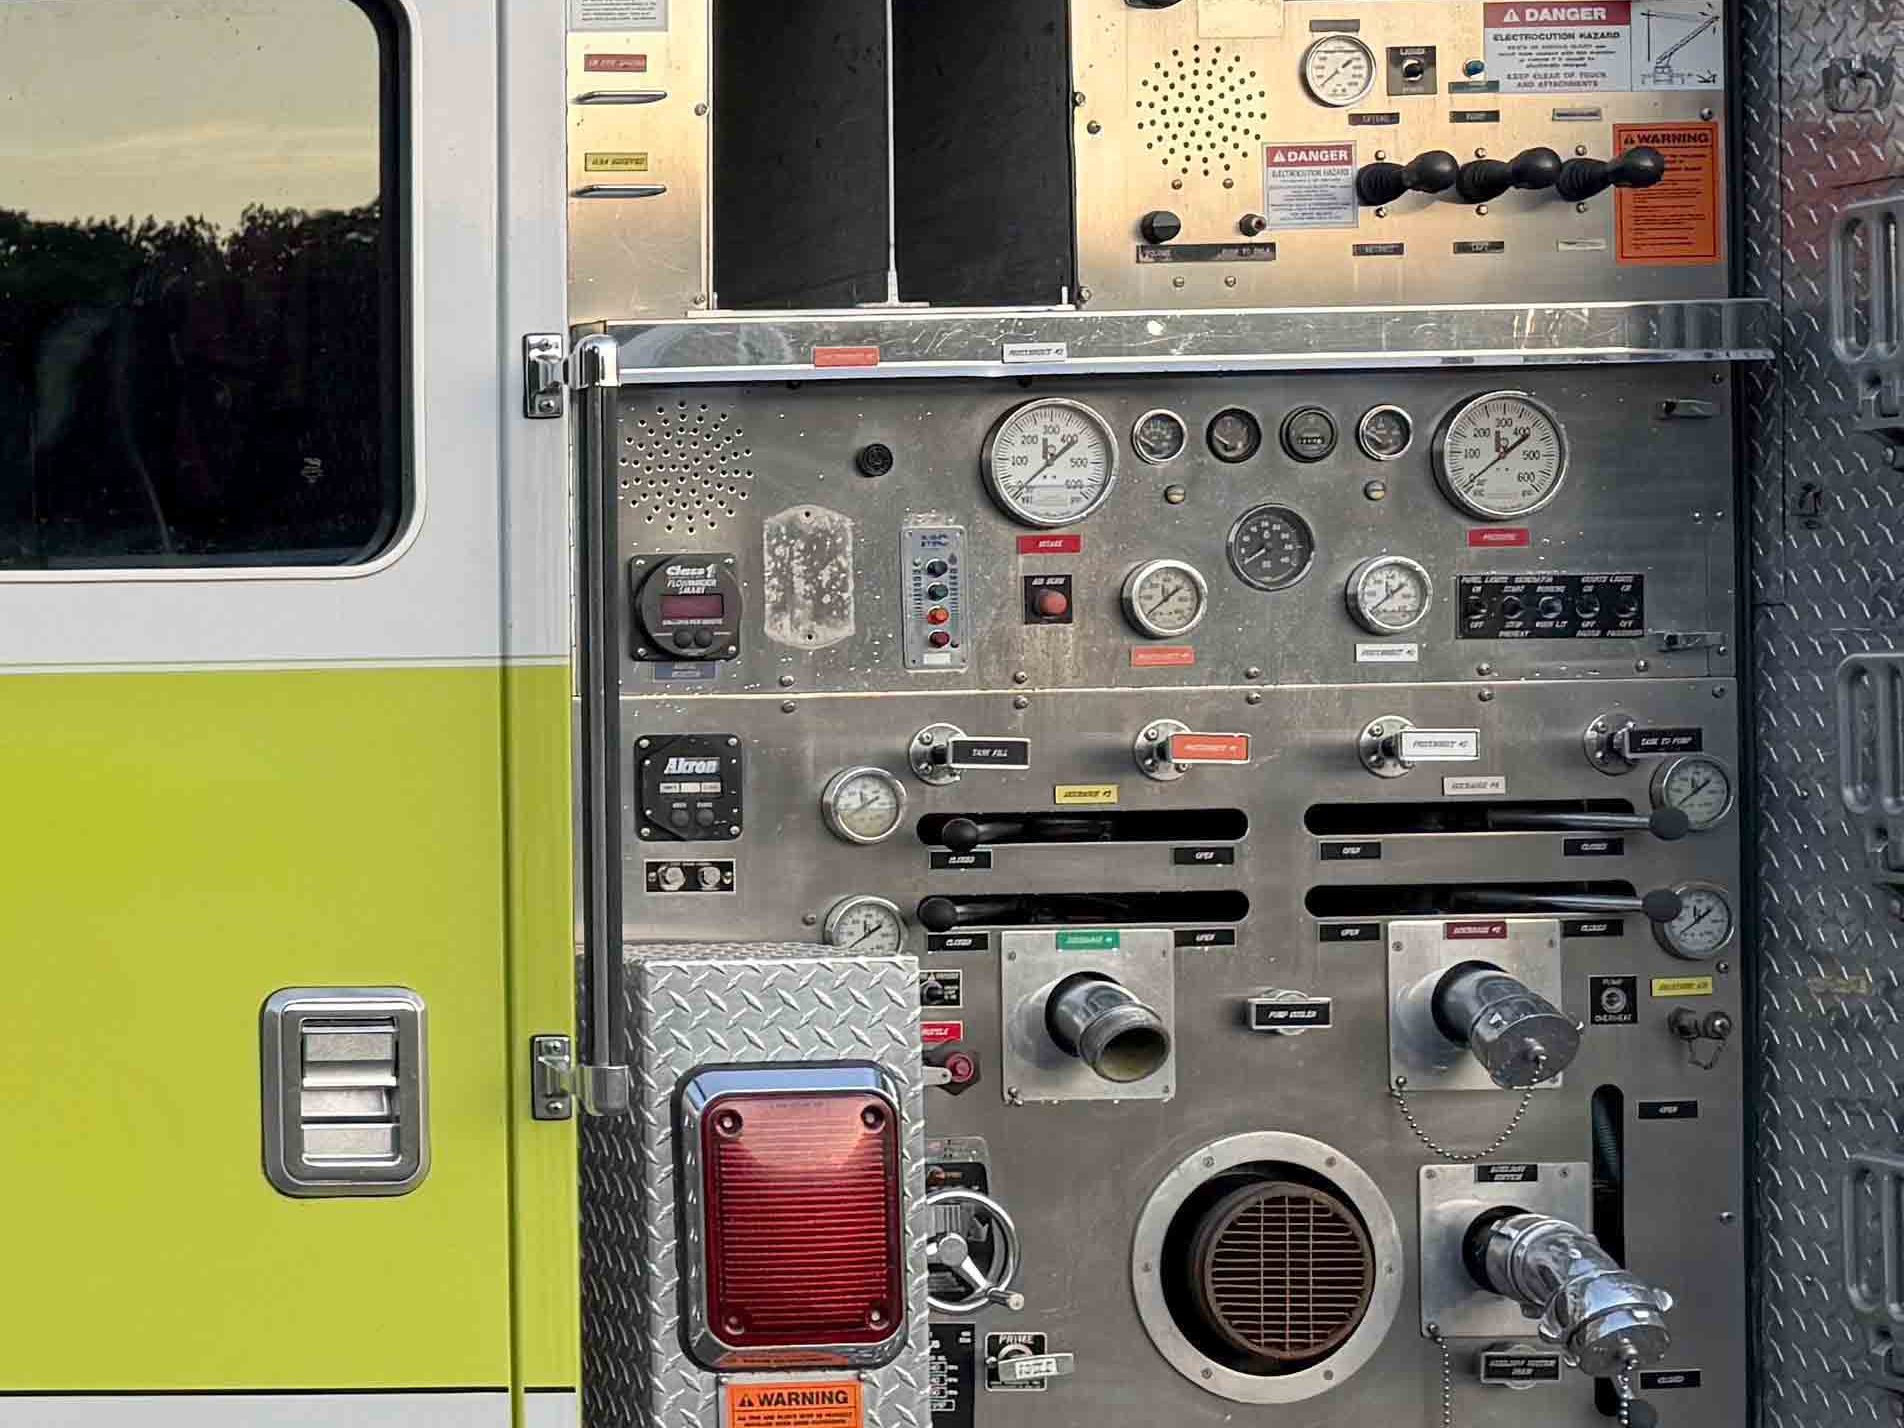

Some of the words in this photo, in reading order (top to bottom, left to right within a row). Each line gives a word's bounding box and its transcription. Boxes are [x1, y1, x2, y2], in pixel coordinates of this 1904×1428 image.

[1525, 8, 1607, 21] DANGER
[1493, 33, 1575, 42] ELECTROCUTION
[1579, 31, 1620, 40] HAZARD
[1638, 132, 1709, 144] WARNING
[1287, 149, 1348, 162] DANGER
[1495, 418, 1513, 428] 300
[1042, 425, 1060, 435] 300
[1473, 427, 1490, 438] 200
[1512, 426, 1530, 437] 400
[1021, 434, 1039, 445] 200
[1060, 434, 1078, 444] 400
[1463, 448, 1480, 459] 100
[1522, 450, 1540, 461] 500
[1011, 455, 1028, 466] 100
[1070, 457, 1088, 468] 500
[1517, 471, 1535, 482] 600
[666, 565, 706, 576] Class
[706, 563, 717, 578] 1
[664, 757, 720, 774] Akron
[1195, 852, 1214, 860] OPEN
[1195, 934, 1215, 942] OPEN
[1341, 929, 1360, 937] OPEN
[758, 1390, 849, 1407] WARNING
